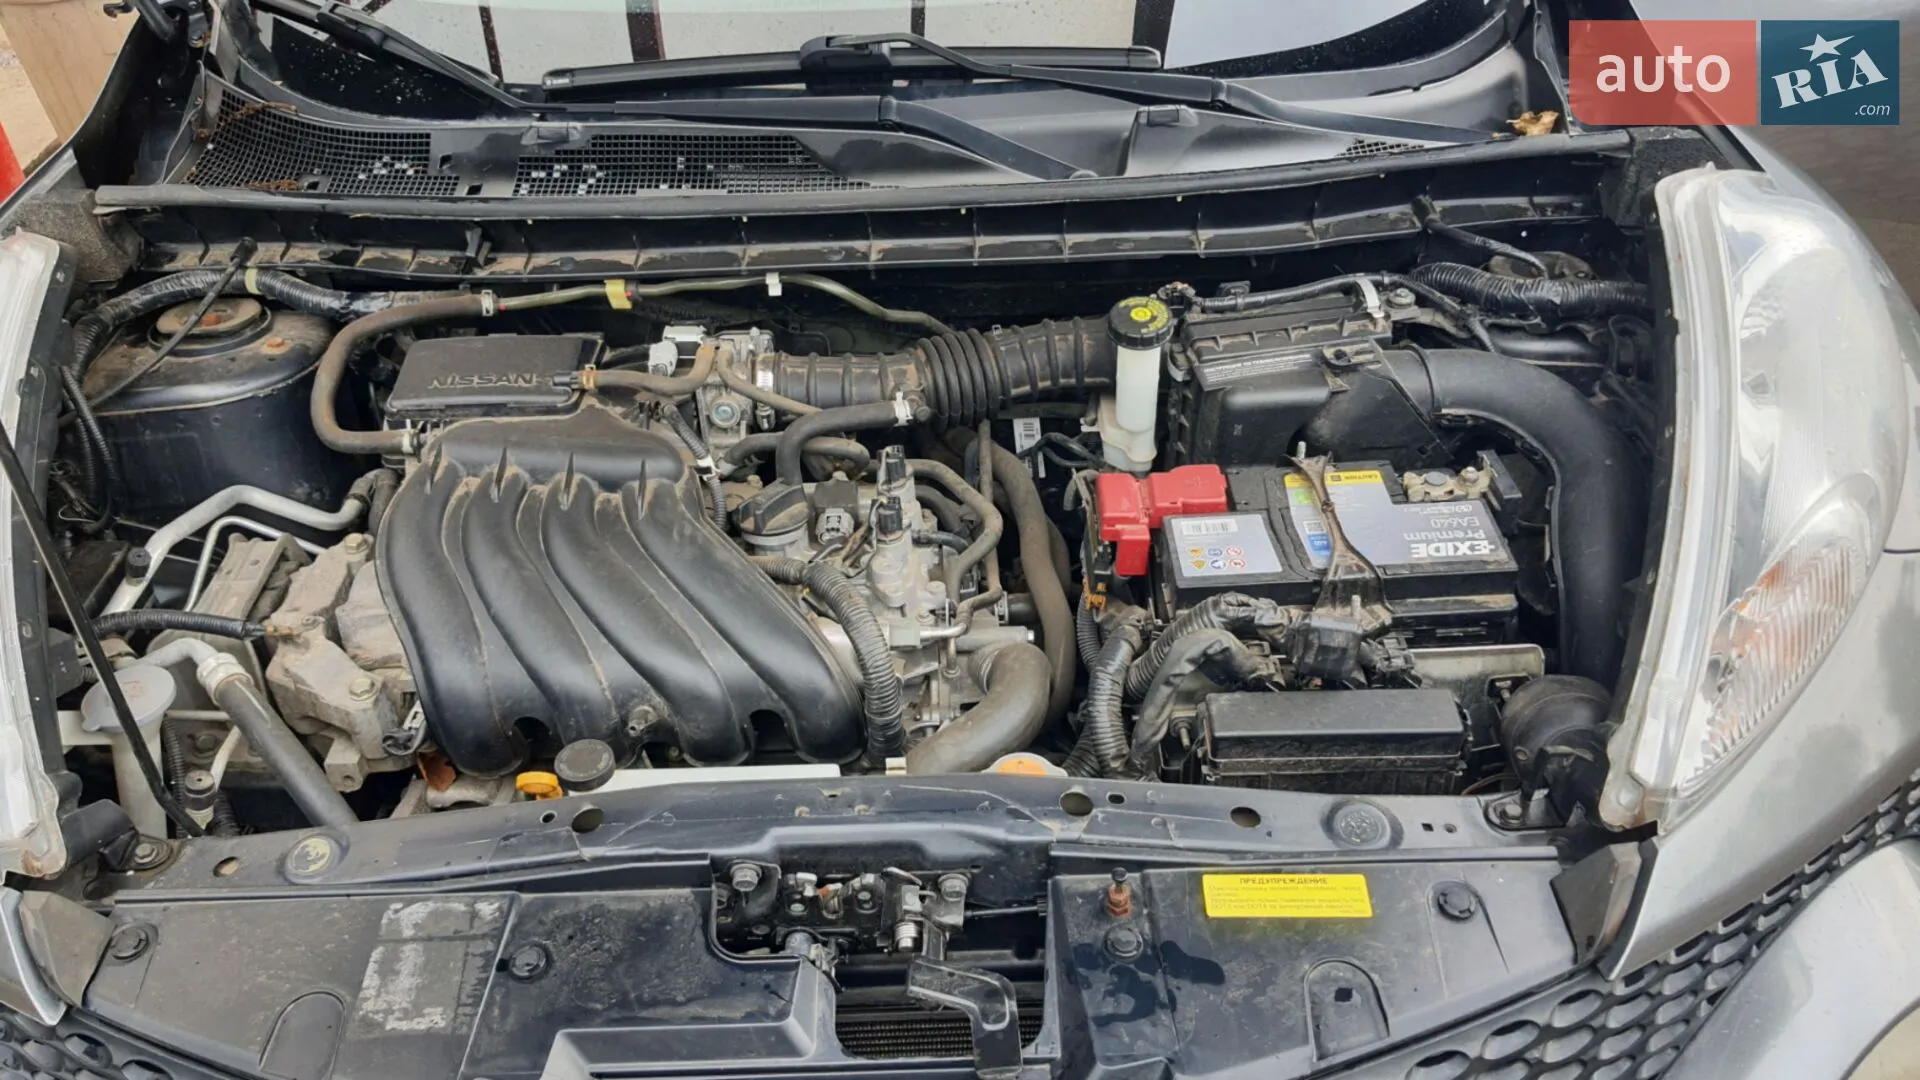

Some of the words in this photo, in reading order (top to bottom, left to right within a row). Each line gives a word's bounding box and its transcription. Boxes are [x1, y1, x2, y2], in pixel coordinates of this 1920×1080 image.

[428, 373, 537, 389] NISSAN
[1403, 528, 1486, 542] Premium
[1411, 540, 1491, 559] EXIDE
[1239, 877, 1329, 886] ПРЕДУПРЕЖДЕНИЕ
